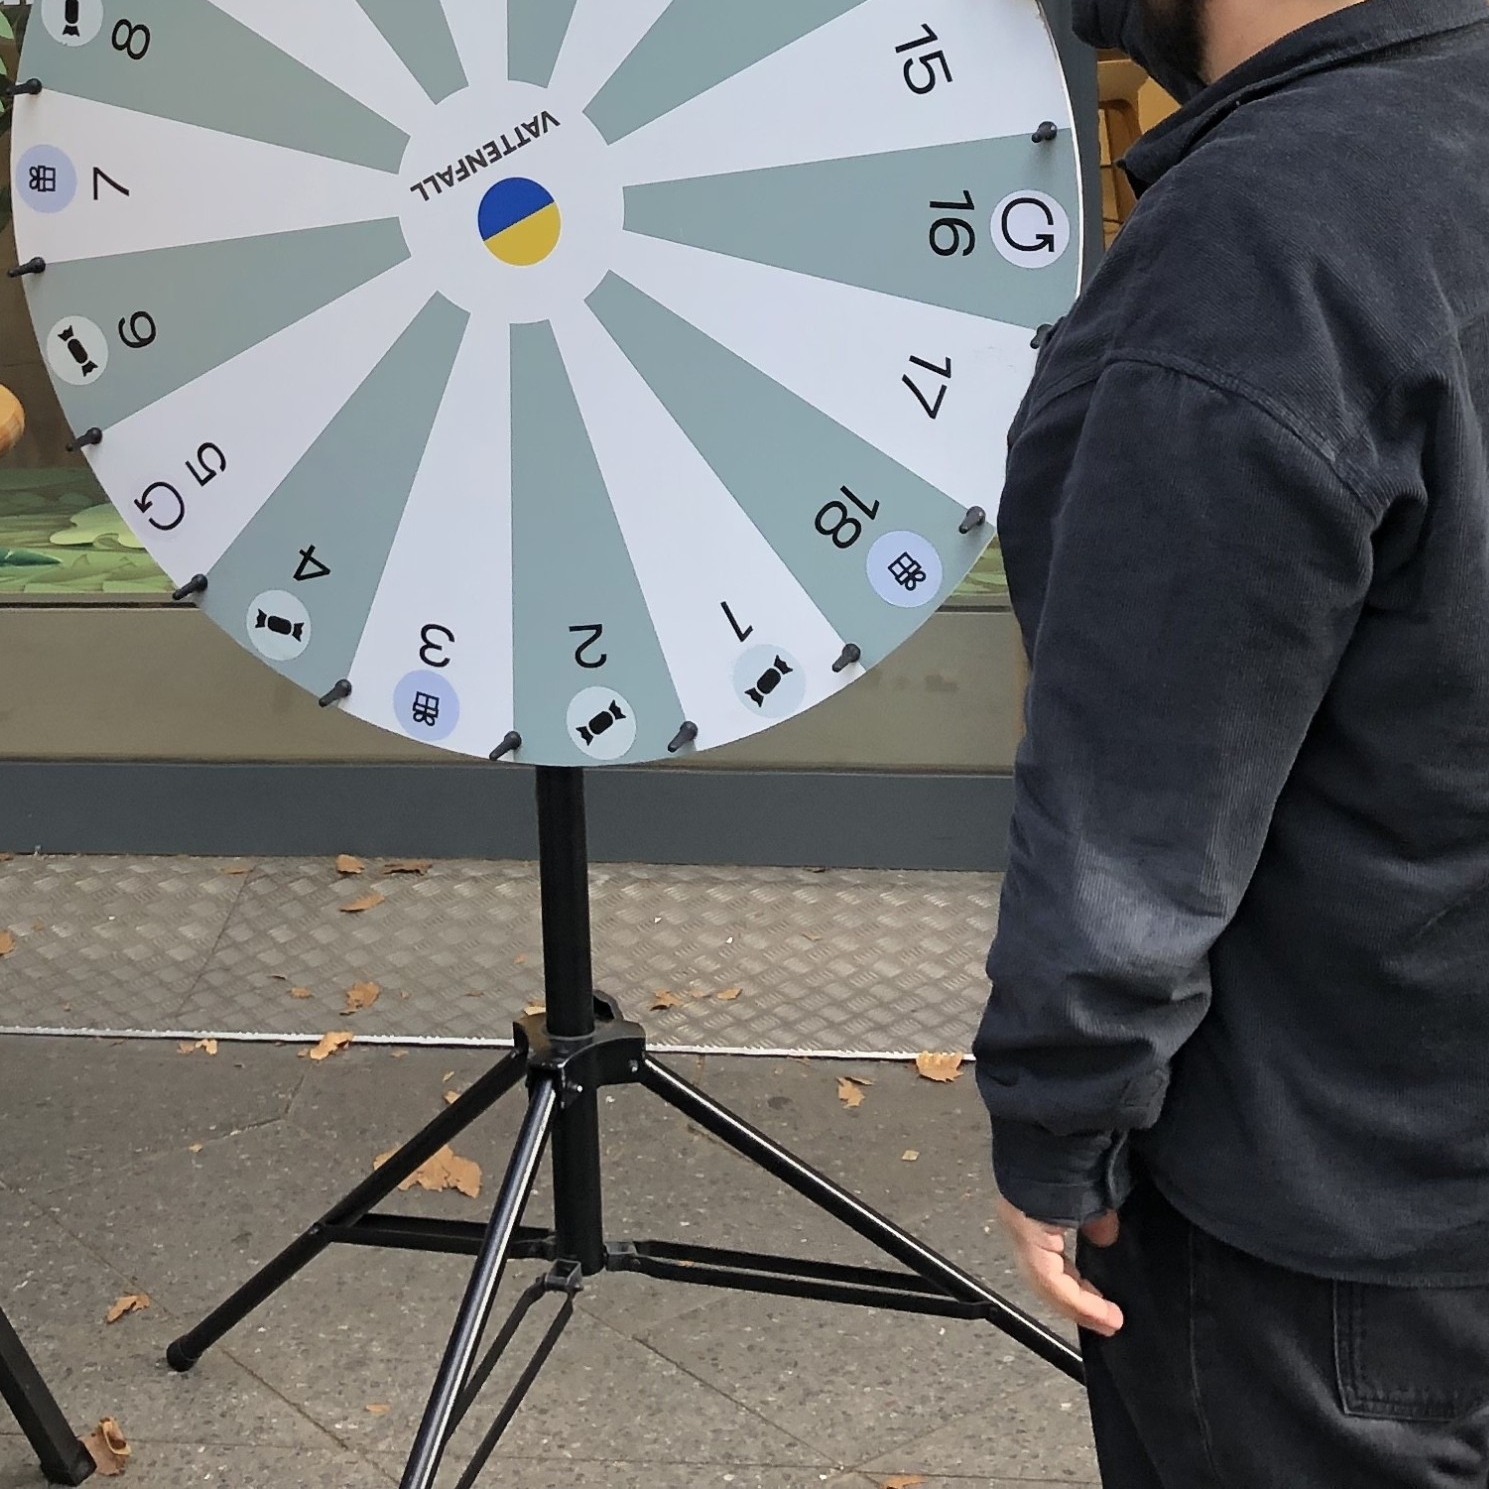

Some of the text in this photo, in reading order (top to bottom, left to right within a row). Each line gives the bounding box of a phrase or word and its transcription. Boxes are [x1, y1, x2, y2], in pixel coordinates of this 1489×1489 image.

[111, 18, 151, 60] 8
[894, 23, 953, 95] 15
[410, 111, 560, 201] VATTENFALL
[92, 166, 130, 200] 7
[929, 189, 976, 256] 16
[118, 310, 157, 348] 6
[902, 354, 952, 419] 17
[185, 442, 227, 486] 5
[814, 485, 880, 548] 18
[293, 544, 331, 582] 4
[720, 601, 753, 642] 1
[420, 624, 455, 668] 3
[569, 624, 607, 668] 2
